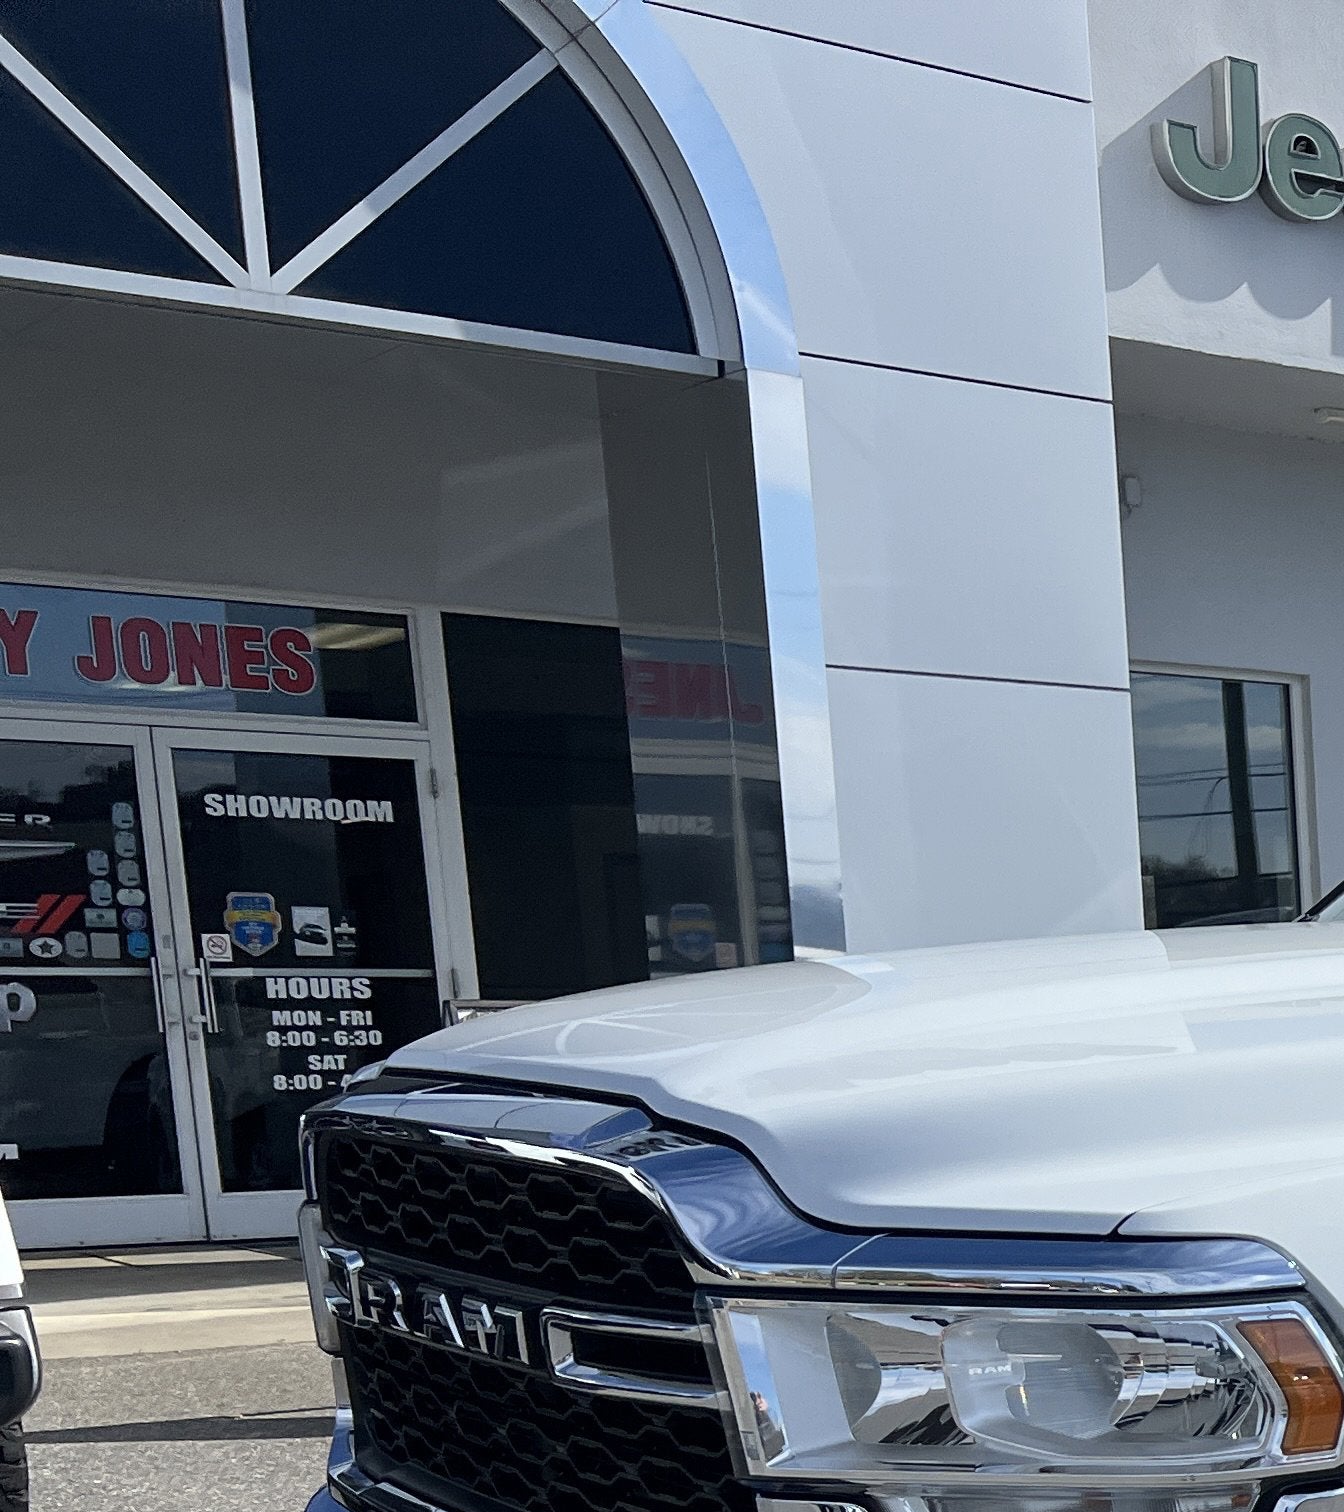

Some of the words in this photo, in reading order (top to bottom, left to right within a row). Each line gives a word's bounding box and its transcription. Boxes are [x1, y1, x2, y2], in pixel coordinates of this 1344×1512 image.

[75, 614, 317, 696] JONES
[203, 793, 395, 823] SHOWROOM
[265, 977, 372, 999] HOURS
[271, 1010, 323, 1026] MON
[340, 1010, 373, 1026] FRI
[266, 1030, 317, 1047] 8:00
[333, 1030, 383, 1046] 6:30
[307, 1054, 348, 1071] SAT
[273, 1074, 323, 1091] 8:00
[352, 1267, 530, 1365] RAM
